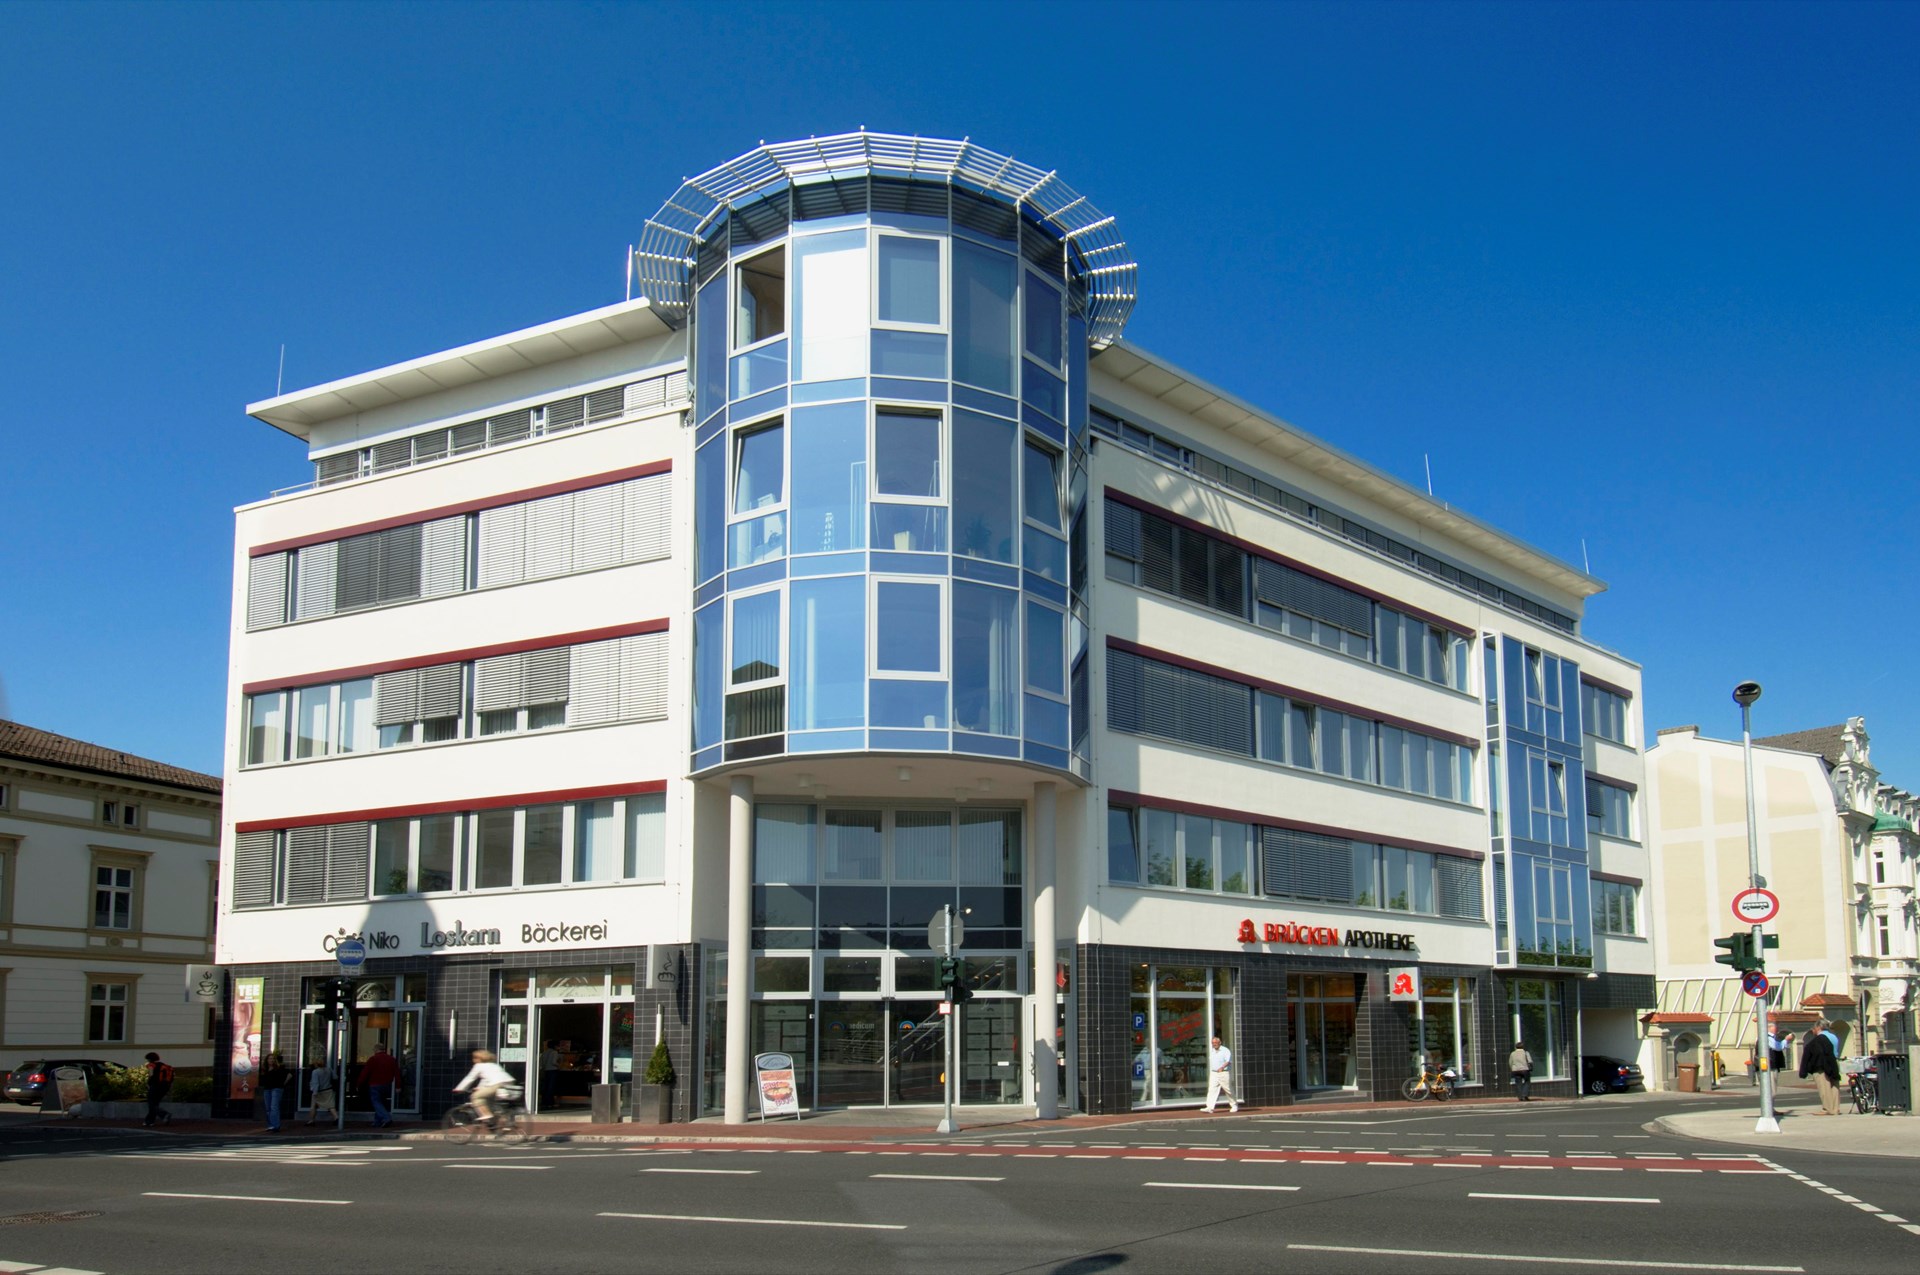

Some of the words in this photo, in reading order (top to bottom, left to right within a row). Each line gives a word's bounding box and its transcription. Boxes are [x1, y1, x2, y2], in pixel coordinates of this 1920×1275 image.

[369, 931, 400, 950] Niko
[420, 919, 501, 948] Loskarn
[521, 919, 608, 944] Bäckerei
[1263, 920, 1339, 946] BRÜCKEN
[1343, 929, 1416, 951] APOTHEKE
[238, 984, 260, 997] TEE
[1135, 1016, 1143, 1027] P
[1136, 1064, 1144, 1075] P
